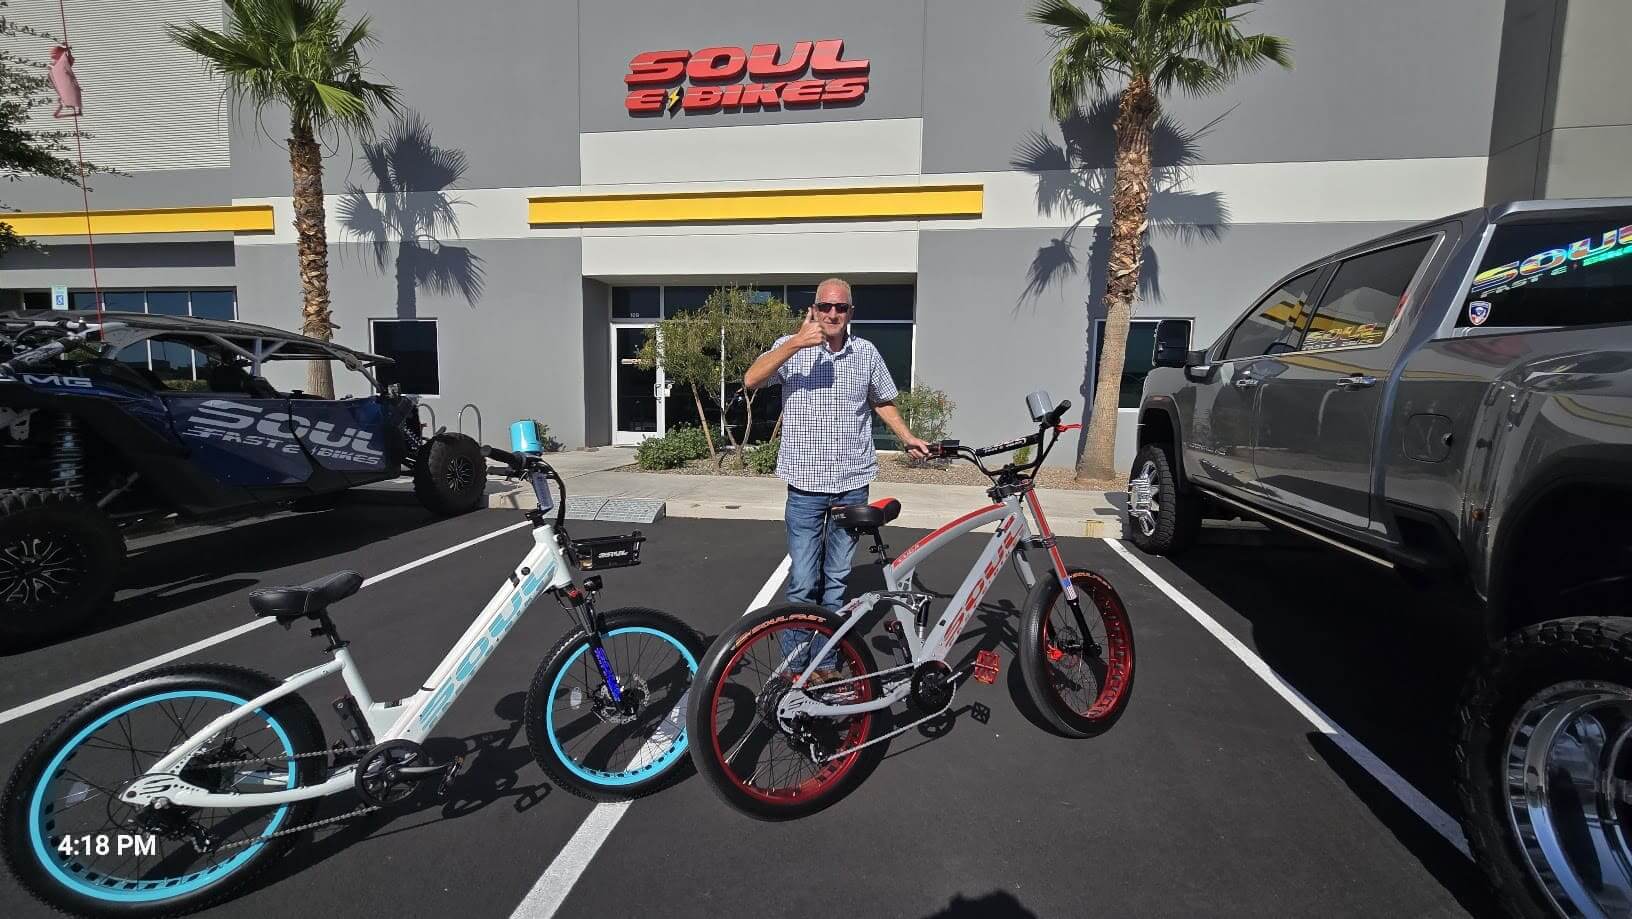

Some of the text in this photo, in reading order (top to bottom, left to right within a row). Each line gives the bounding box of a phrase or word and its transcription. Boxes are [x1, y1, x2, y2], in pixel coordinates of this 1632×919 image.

[624, 39, 870, 88] SOUL
[182, 425, 284, 449] FAST
[188, 400, 383, 456] SOUL
[943, 523, 1024, 649] SOUL
[419, 560, 558, 731] SOUL
